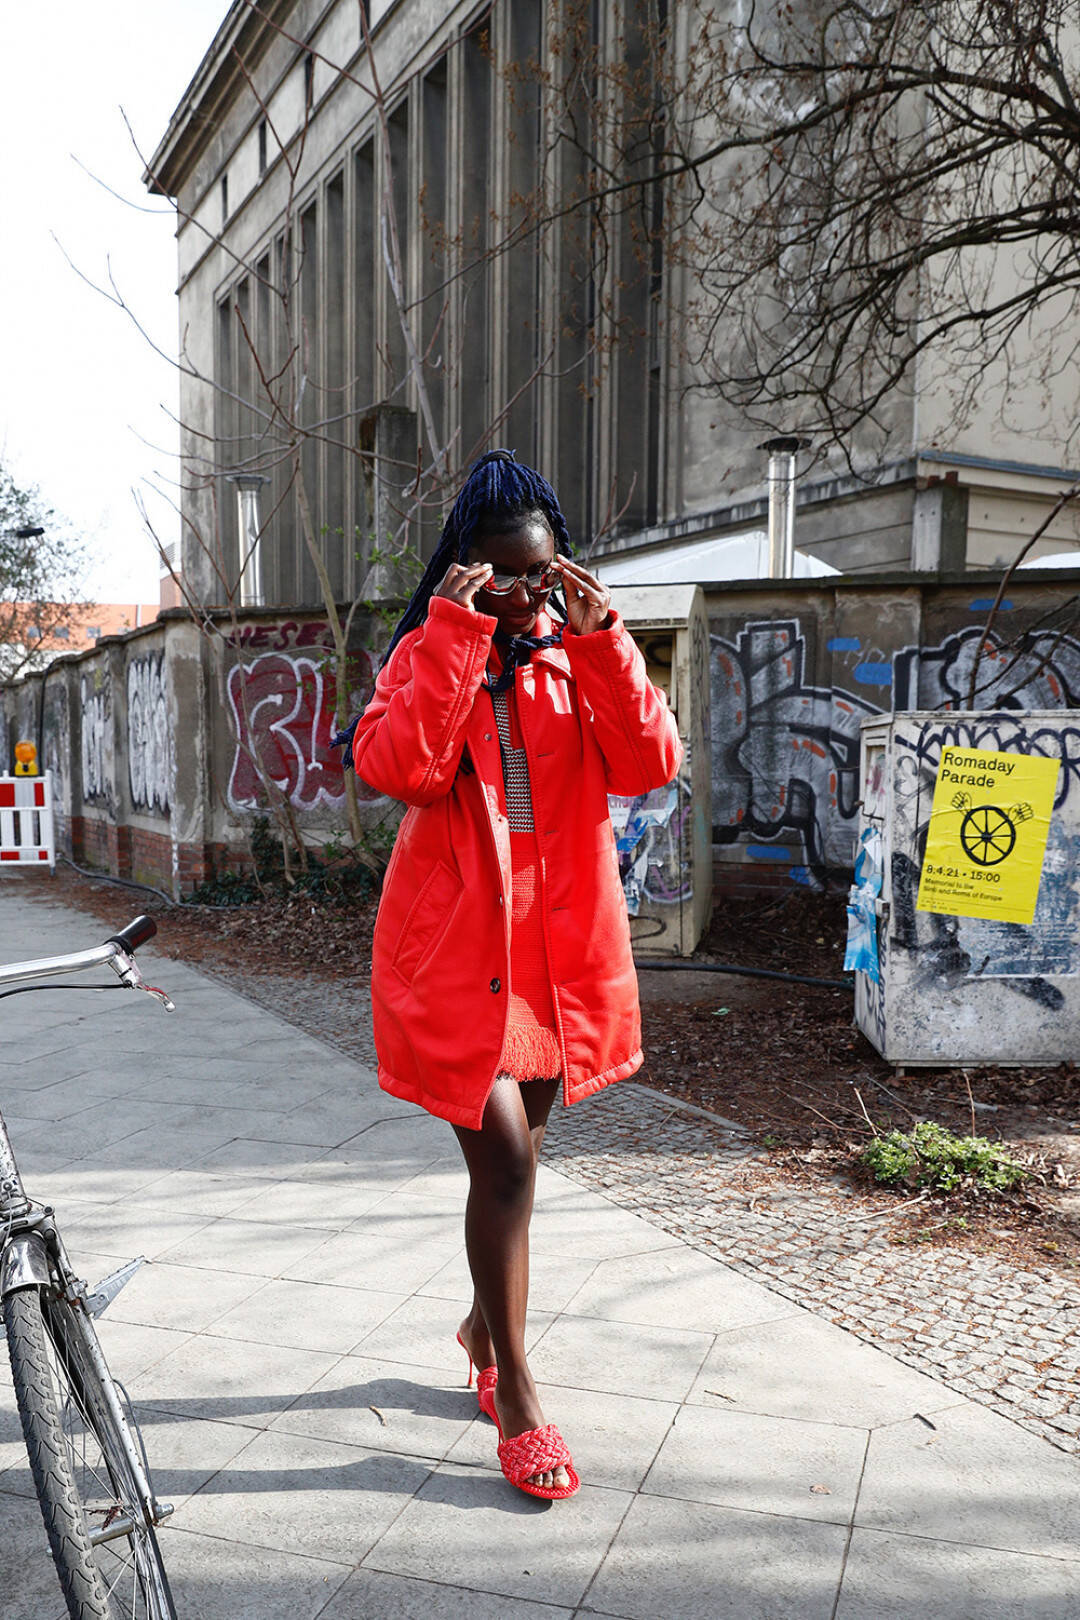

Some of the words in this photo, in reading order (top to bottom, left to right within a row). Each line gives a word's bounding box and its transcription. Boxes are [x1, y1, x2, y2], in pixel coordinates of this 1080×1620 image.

[943, 752, 1016, 776] Romaday
[941, 769, 995, 788] Parade
[926, 864, 960, 878] 8.4.21
[970, 871, 1001, 883] 15:00
